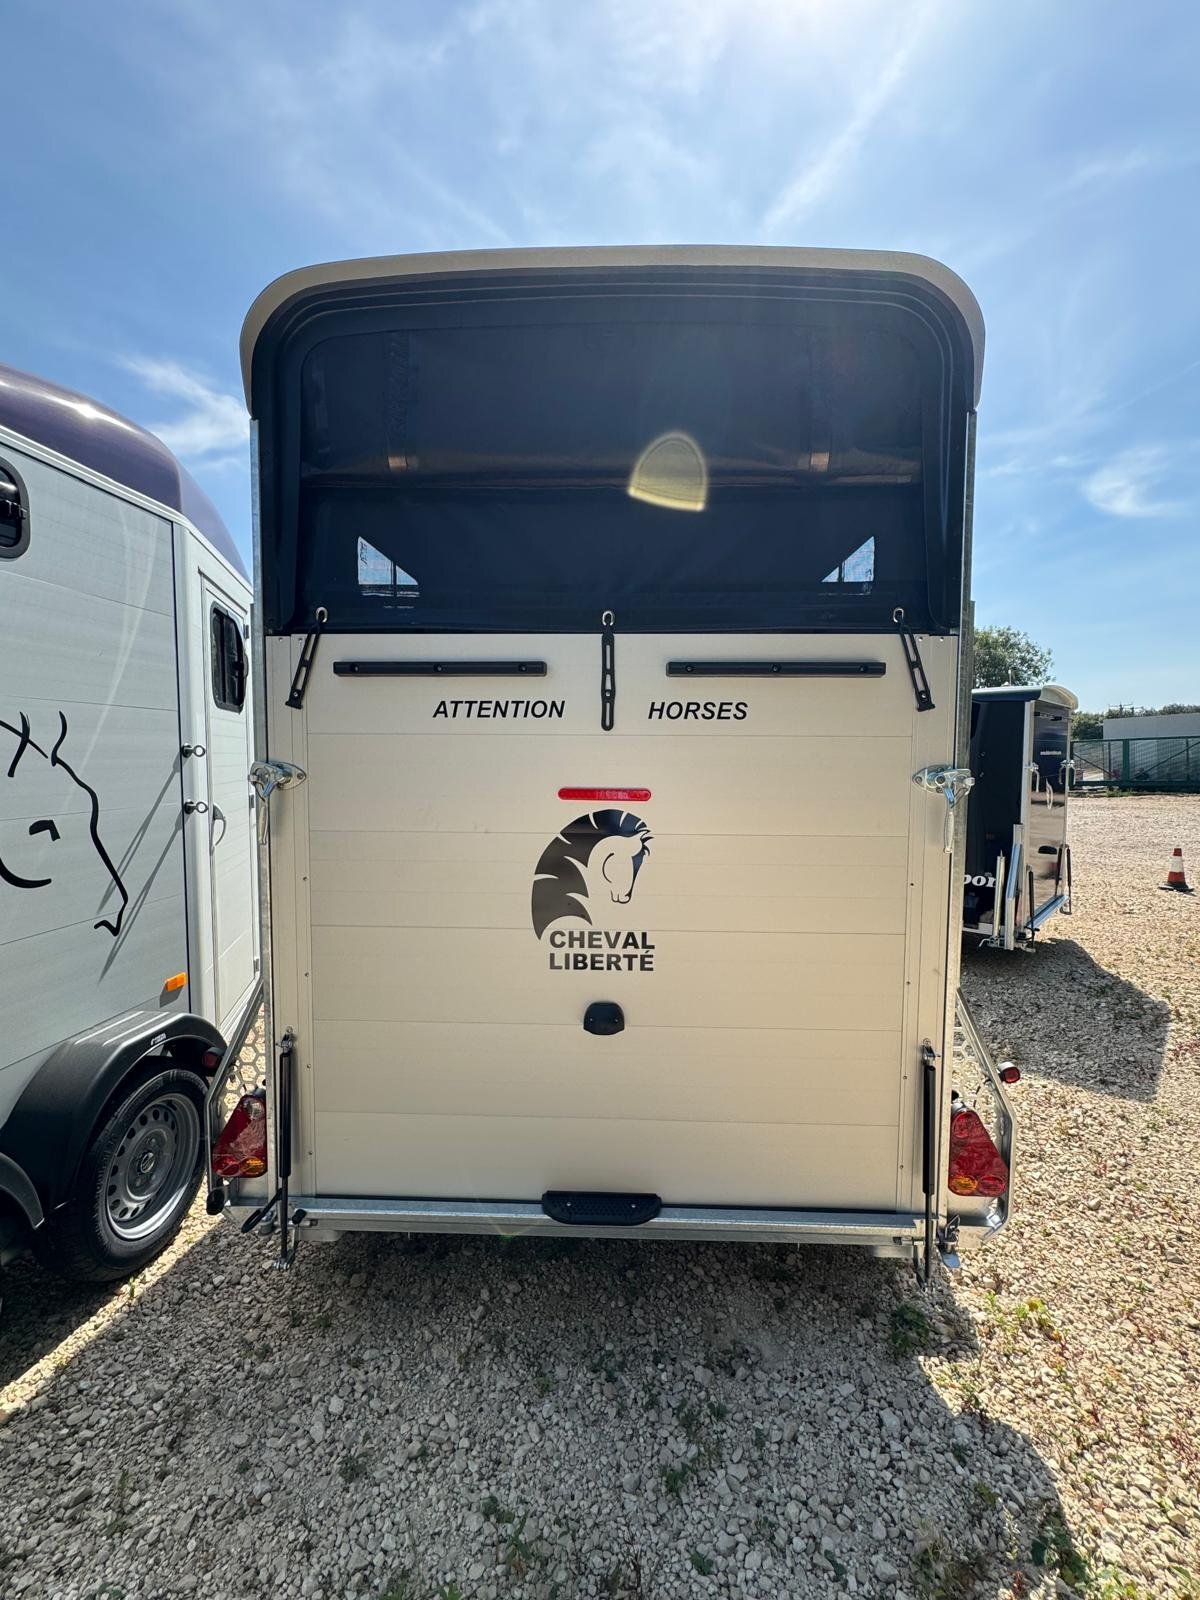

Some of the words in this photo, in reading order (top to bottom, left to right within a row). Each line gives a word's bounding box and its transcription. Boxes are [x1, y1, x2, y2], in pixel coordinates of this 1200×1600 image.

[432, 700, 565, 719] ATTENTION
[648, 701, 748, 720] HORSES
[549, 930, 655, 950] CHEVAL
[549, 950, 654, 971] LIBERTÉ
